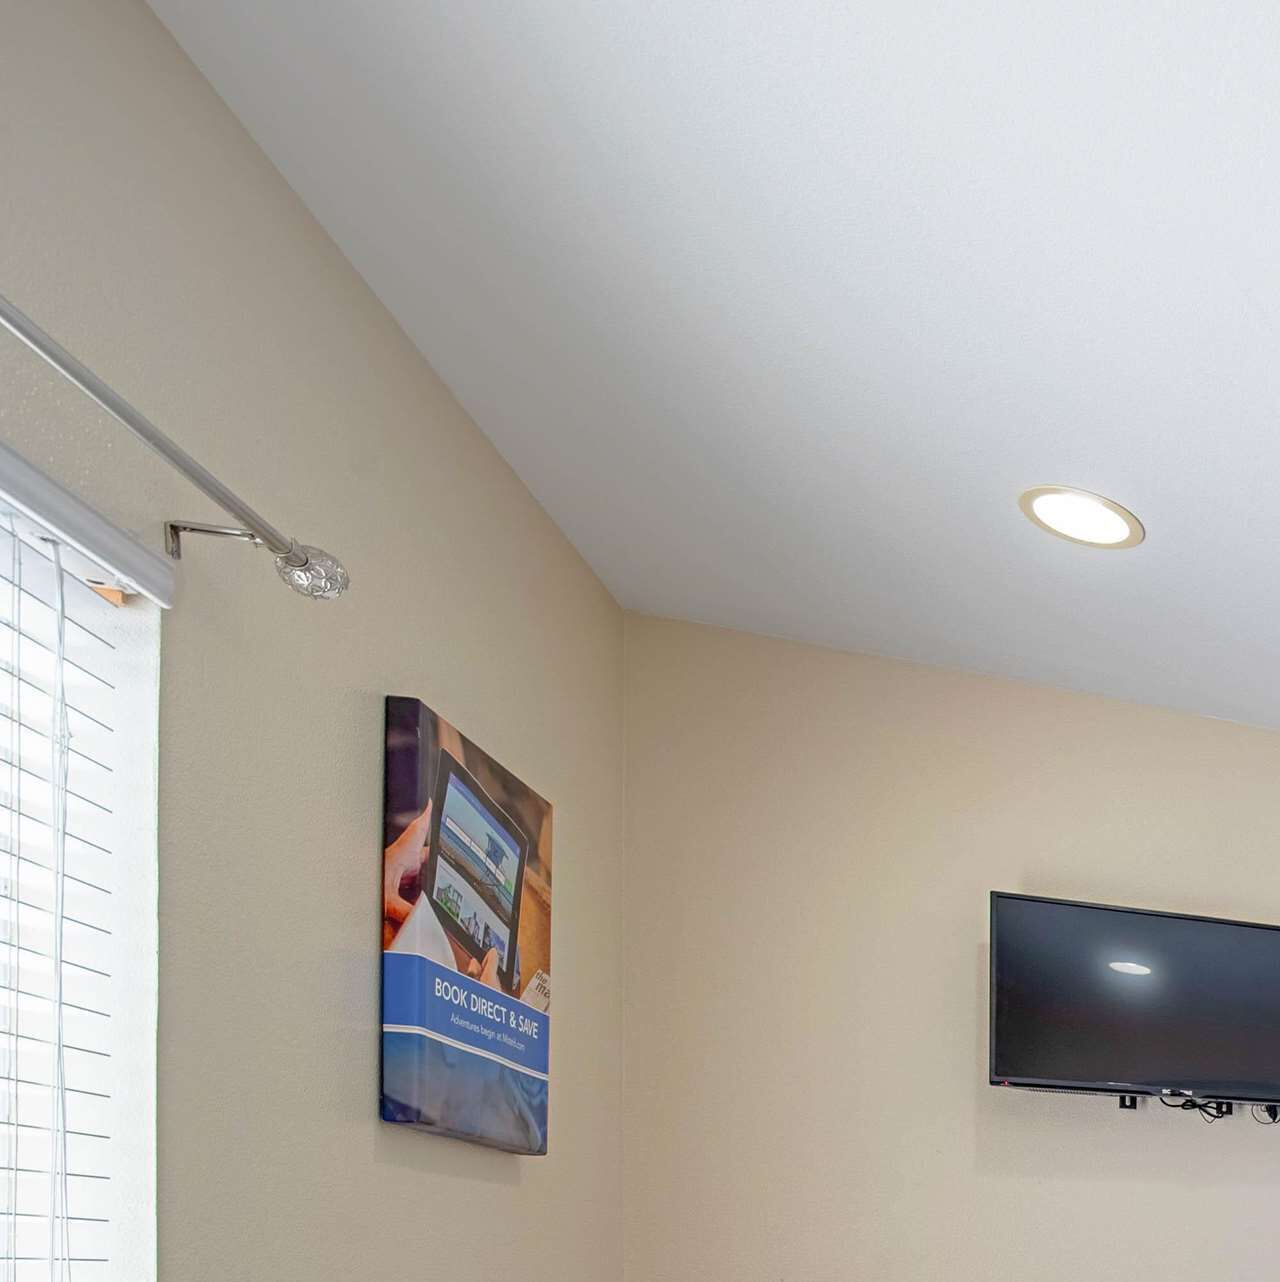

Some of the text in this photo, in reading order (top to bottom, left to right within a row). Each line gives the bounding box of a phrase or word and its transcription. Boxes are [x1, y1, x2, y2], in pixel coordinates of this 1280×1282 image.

[435, 977, 539, 1039] BOOK DIRECT & SAVE
